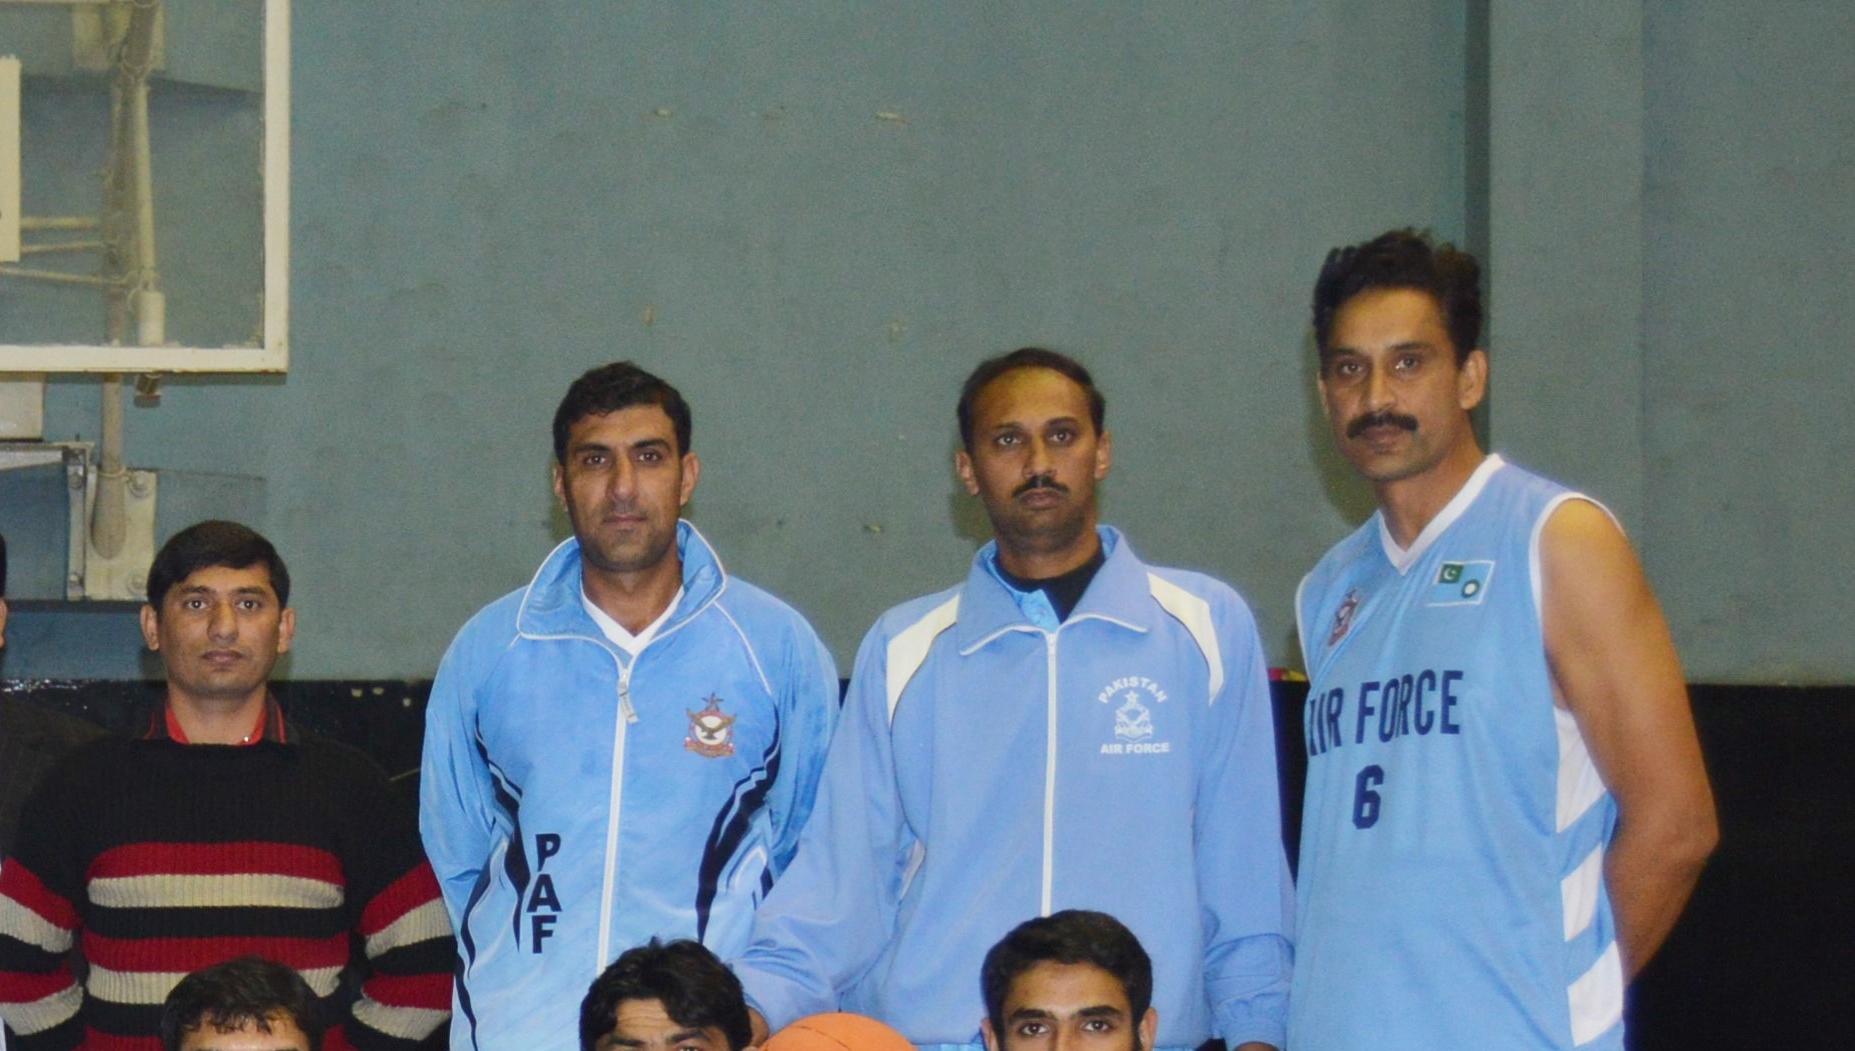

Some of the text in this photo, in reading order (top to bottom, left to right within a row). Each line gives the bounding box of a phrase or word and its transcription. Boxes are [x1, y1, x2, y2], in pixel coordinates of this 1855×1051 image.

[1098, 676, 1167, 704] PAKISTAN
[1355, 669, 1464, 744] FORCE
[1100, 742, 1170, 754] AIR FORCE
[1352, 764, 1385, 830] 6
[526, 832, 562, 954] PAF
